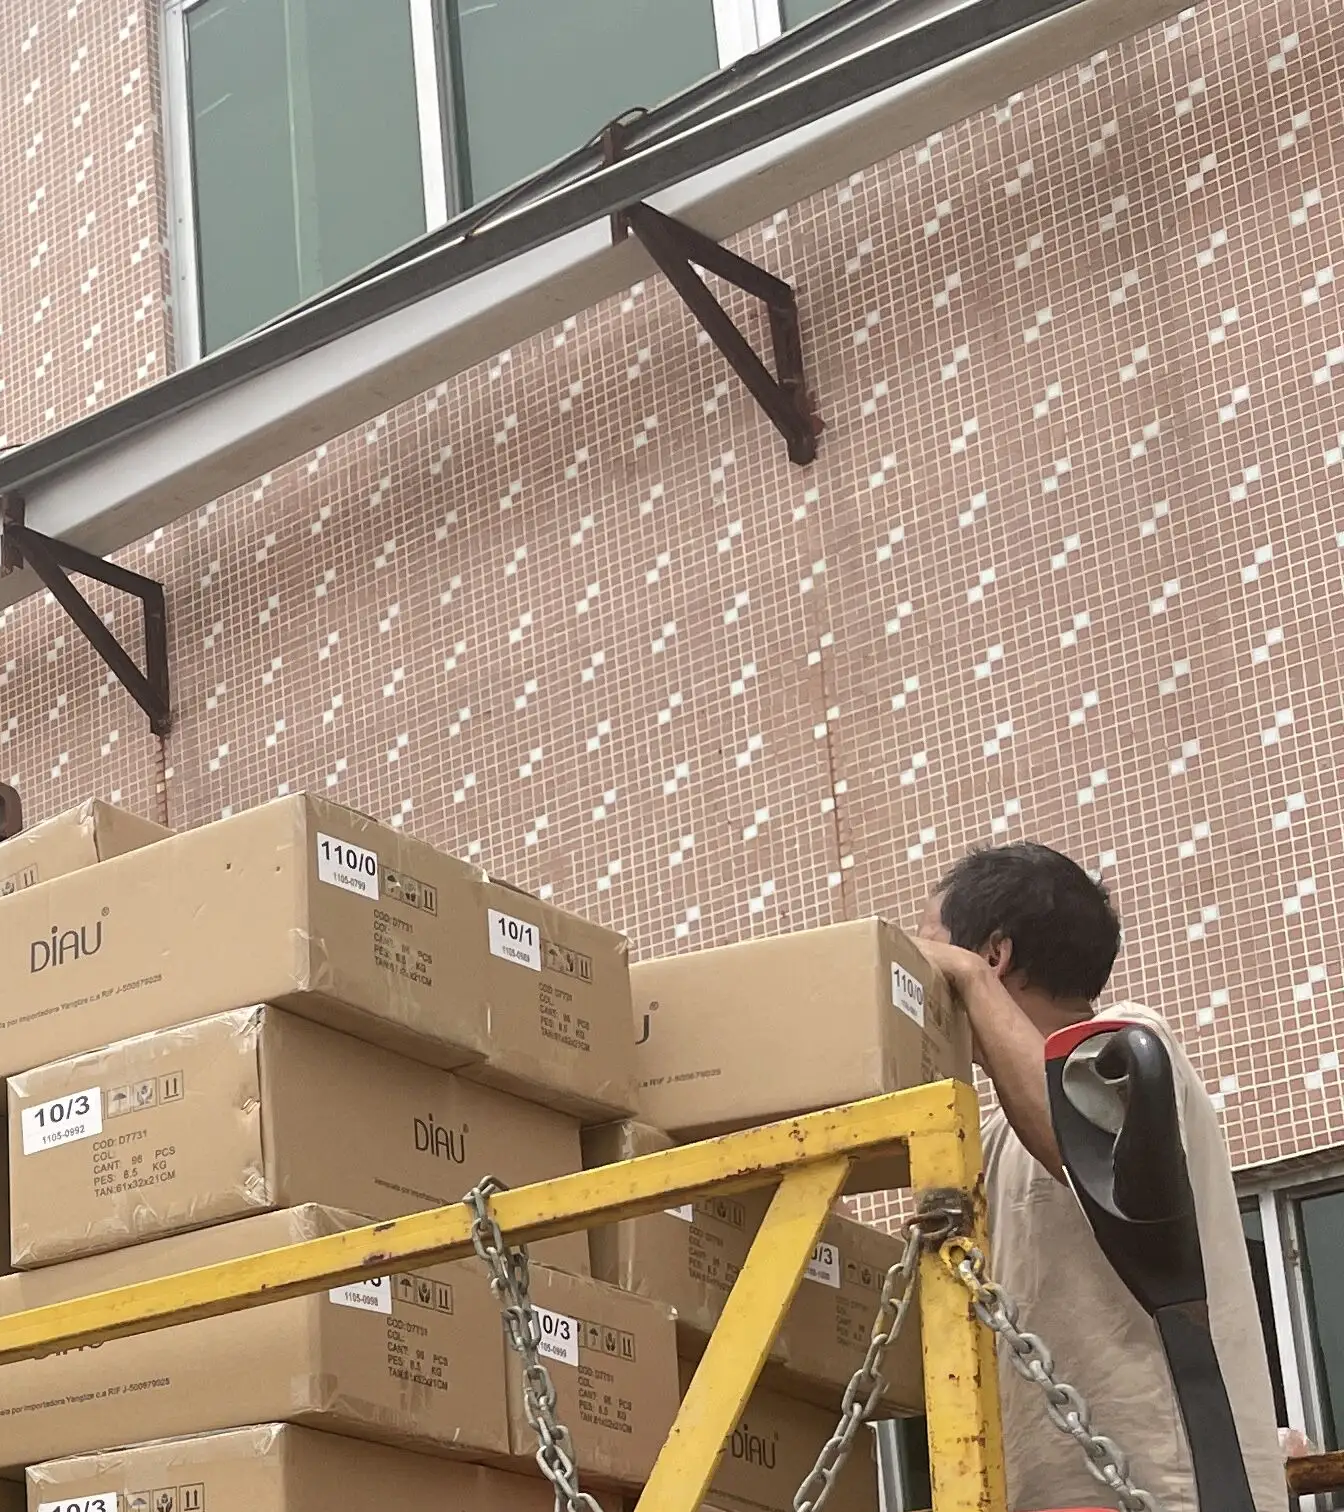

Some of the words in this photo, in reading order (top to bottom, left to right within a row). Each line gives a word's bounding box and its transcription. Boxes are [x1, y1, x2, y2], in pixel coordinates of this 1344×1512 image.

[322, 841, 376, 876] 110/0
[499, 918, 532, 946] 10/1
[894, 968, 924, 1006] 110/0
[34, 1095, 90, 1128] 10/3
[42, 1125, 86, 1145] 1105-0992
[93, 1139, 117, 1151] COD:
[155, 1146, 176, 1160] PCS
[543, 1315, 571, 1340] 0/3
